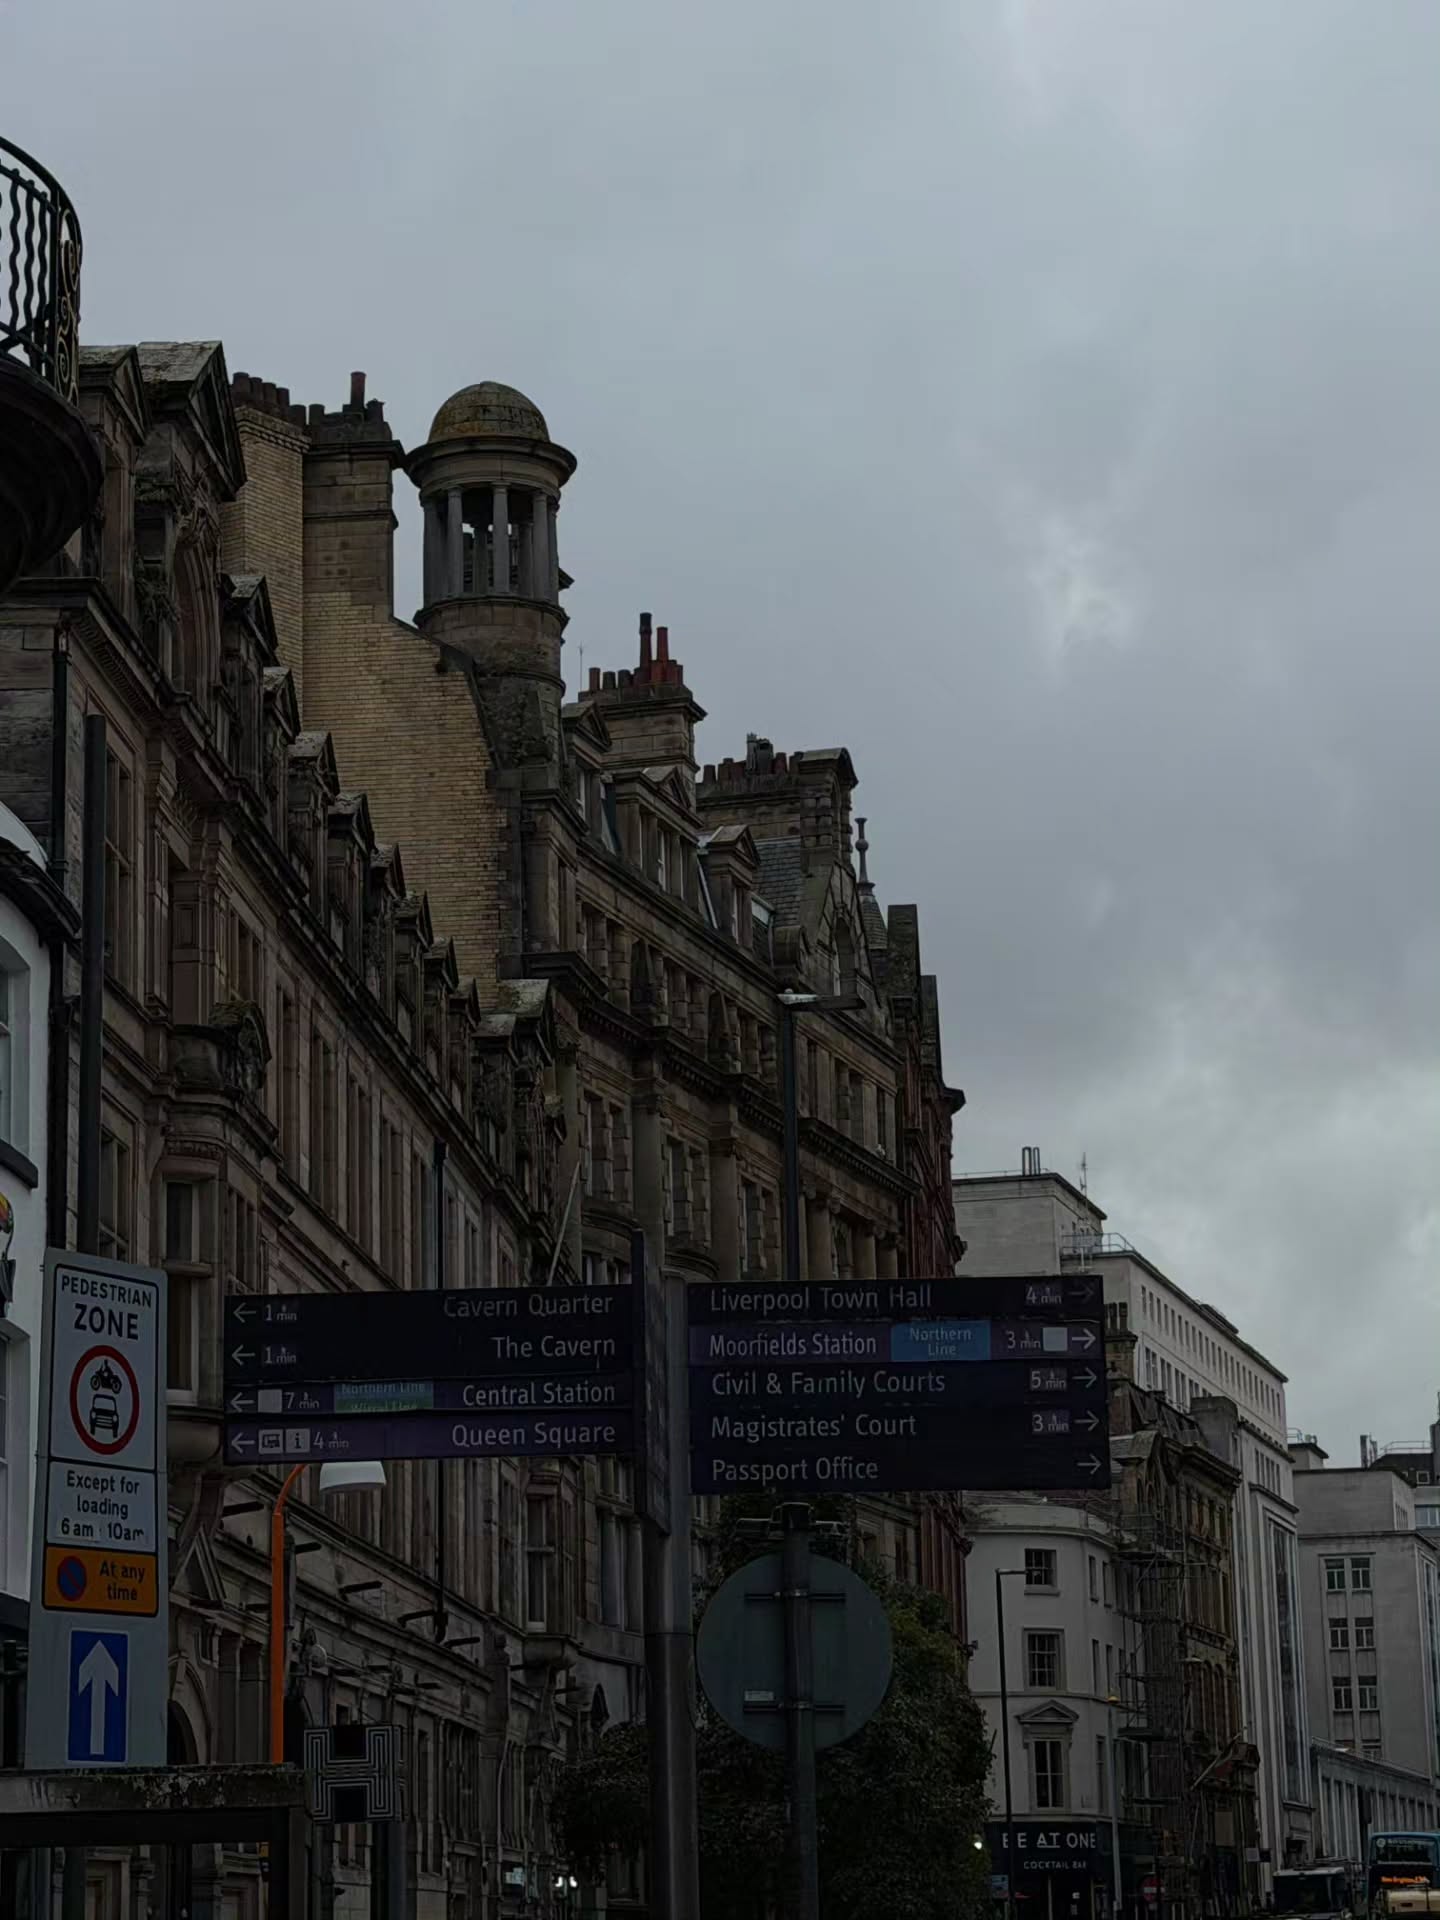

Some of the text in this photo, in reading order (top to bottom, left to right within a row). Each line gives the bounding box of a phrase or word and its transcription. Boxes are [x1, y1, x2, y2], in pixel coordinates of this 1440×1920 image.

[62, 1275, 152, 1308] PEDESTRIAN
[710, 1283, 932, 1317] Liverpool Town Hall
[1025, 1286, 1037, 1304] 4
[265, 1304, 273, 1321] 1
[443, 1294, 614, 1317] Cavern Quarter
[74, 1303, 139, 1340] ZONE
[709, 1331, 877, 1357] Moorfields Station
[909, 1327, 973, 1342] Northern
[1006, 1331, 1017, 1349] 3
[265, 1346, 273, 1364] 1
[490, 1335, 616, 1359] The Cavern
[928, 1343, 957, 1356] Line
[712, 1370, 946, 1398] Civil & Family Courts
[1031, 1371, 1041, 1389] 5
[284, 1393, 294, 1409] 7
[463, 1379, 616, 1407] Central Station
[712, 1413, 917, 1444] Magistrates' Court
[1033, 1414, 1043, 1432] 3
[313, 1431, 324, 1449] 4
[452, 1421, 617, 1449] Queen Square
[67, 1470, 140, 1494] Except for
[712, 1456, 880, 1487] Passport Office
[77, 1495, 128, 1520] loading
[100, 1560, 145, 1583] At any
[107, 1582, 138, 1601] time
[1036, 1832, 1061, 1849] AT
[1066, 1832, 1096, 1849] ONE
[1024, 1860, 1069, 1870] COCKTAIL
